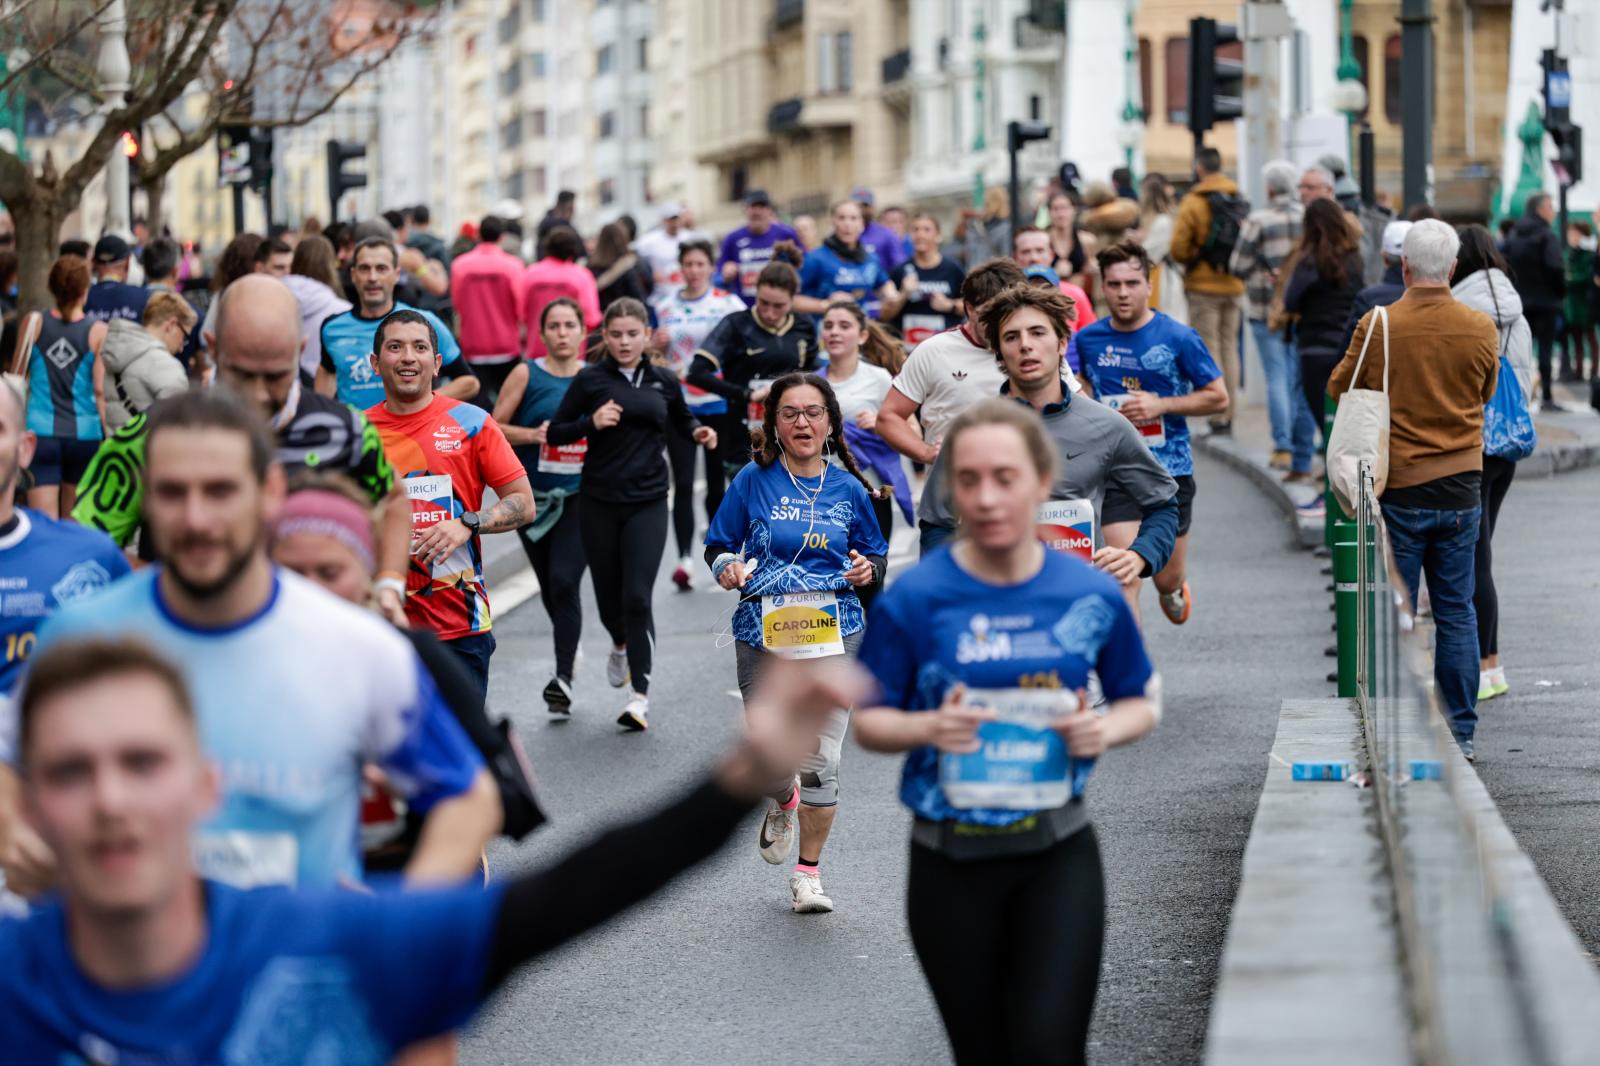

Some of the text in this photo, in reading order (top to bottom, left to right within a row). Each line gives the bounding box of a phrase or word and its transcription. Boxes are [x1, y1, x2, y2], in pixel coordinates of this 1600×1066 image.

[407, 484, 438, 494] URICH
[411, 510, 448, 523] FRET
[802, 533, 830, 550] 10k
[789, 592, 827, 604] ZURICH
[773, 617, 838, 632] CAROLINE
[790, 634, 817, 644] 12701
[6, 632, 37, 662] 10
